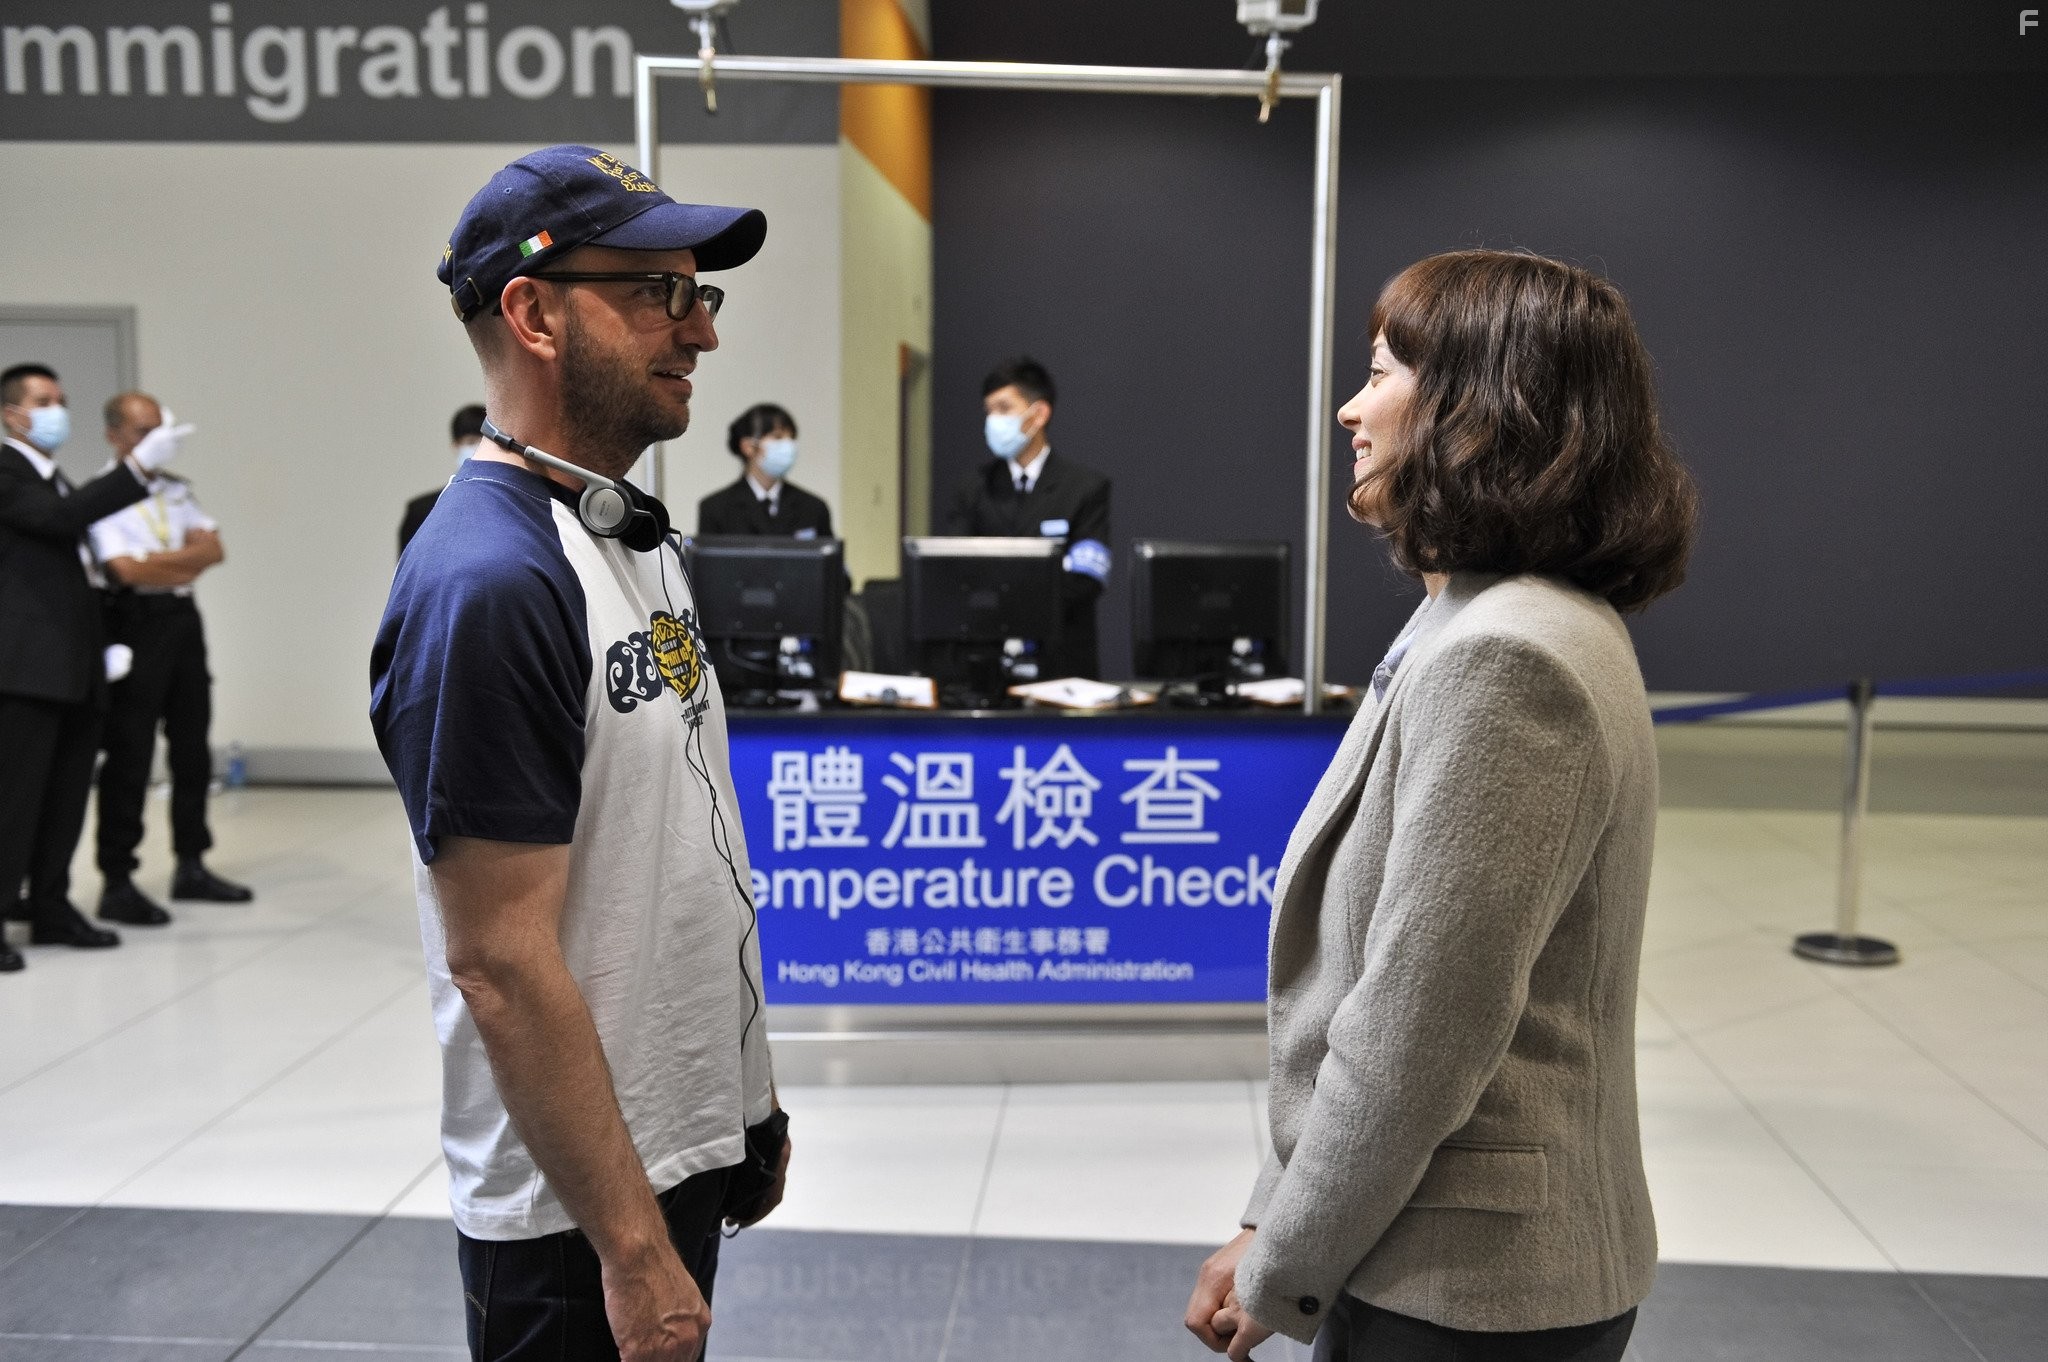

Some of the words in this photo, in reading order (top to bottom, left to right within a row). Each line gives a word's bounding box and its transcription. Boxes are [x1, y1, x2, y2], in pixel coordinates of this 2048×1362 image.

[3, 3, 635, 122] mmigration
[767, 744, 1221, 851] 體溫檢查
[750, 857, 1074, 919] emperature
[1093, 854, 1275, 908] Check
[777, 958, 840, 988] Hong
[843, 958, 904, 988] Kong
[907, 958, 957, 983] Civil
[961, 958, 1034, 983] Health
[1037, 957, 1194, 983] Administration
